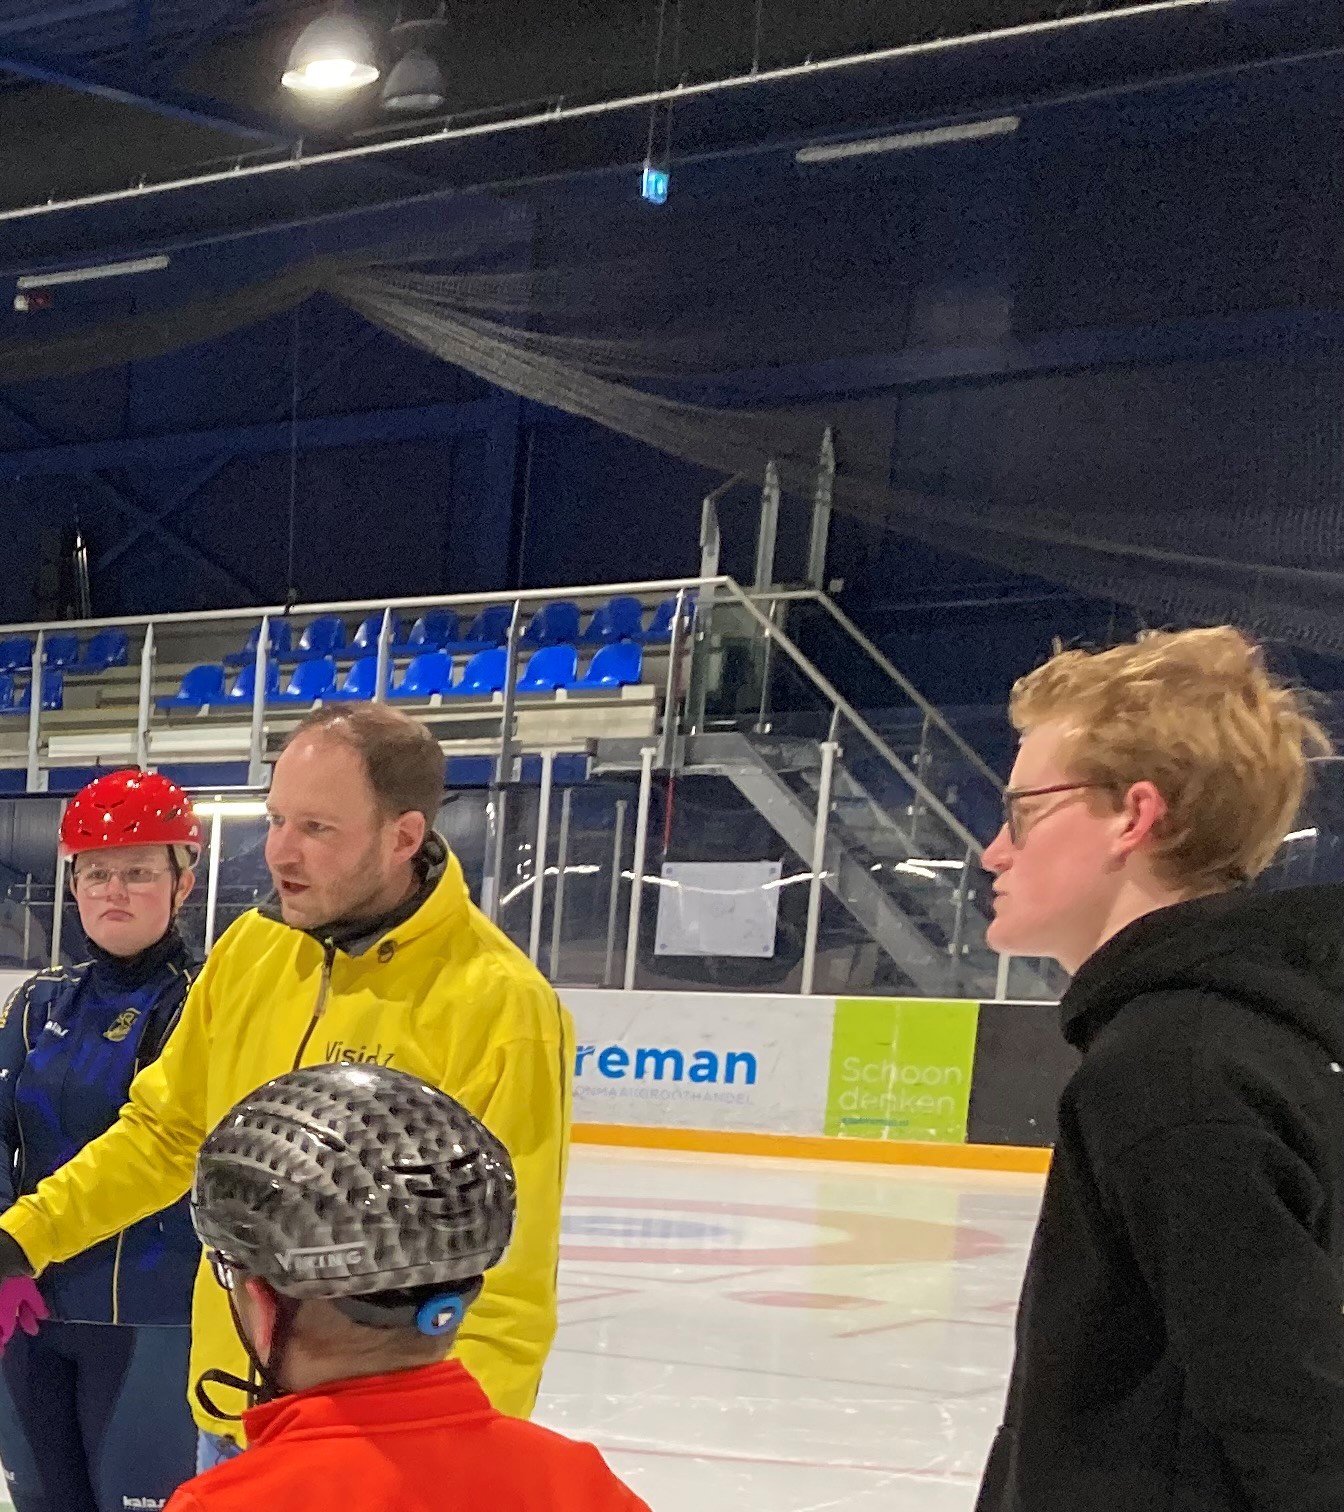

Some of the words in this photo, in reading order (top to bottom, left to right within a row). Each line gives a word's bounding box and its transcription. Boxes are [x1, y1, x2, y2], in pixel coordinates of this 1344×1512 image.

[573, 1043, 759, 1086] reman
[842, 1056, 962, 1086] Schoon
[839, 1085, 956, 1115] denken
[274, 1240, 367, 1272] VIKING
